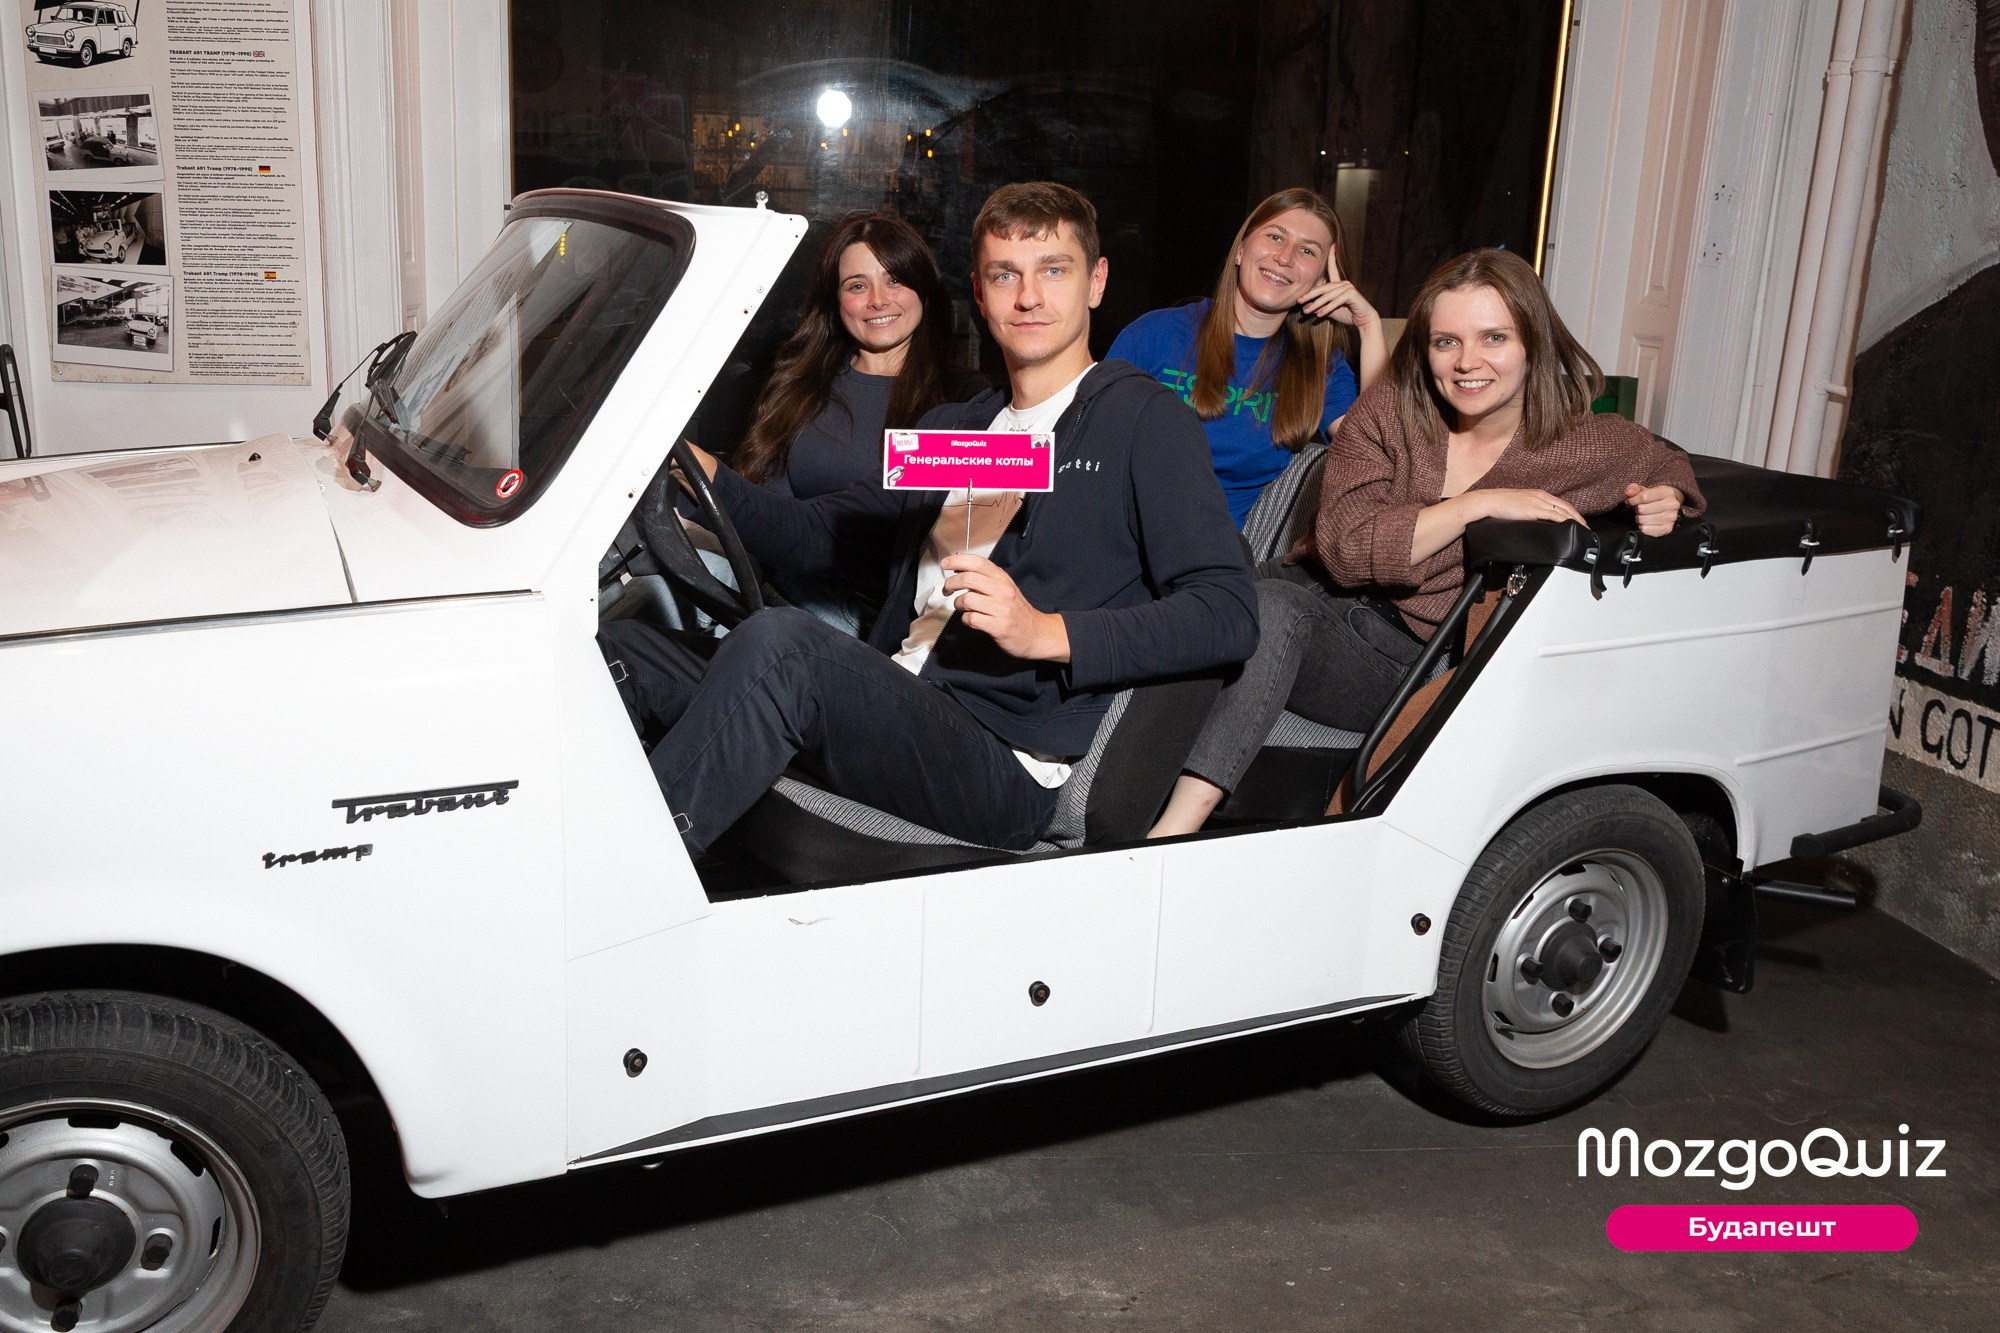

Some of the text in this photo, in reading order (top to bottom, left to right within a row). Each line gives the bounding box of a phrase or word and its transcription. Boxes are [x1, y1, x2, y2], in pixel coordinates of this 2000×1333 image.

[950, 439, 987, 448] MozgoQuiz
[903, 453, 1034, 467] Генеральские котлы
[331, 779, 520, 824] Trabant
[262, 843, 374, 869] tramp
